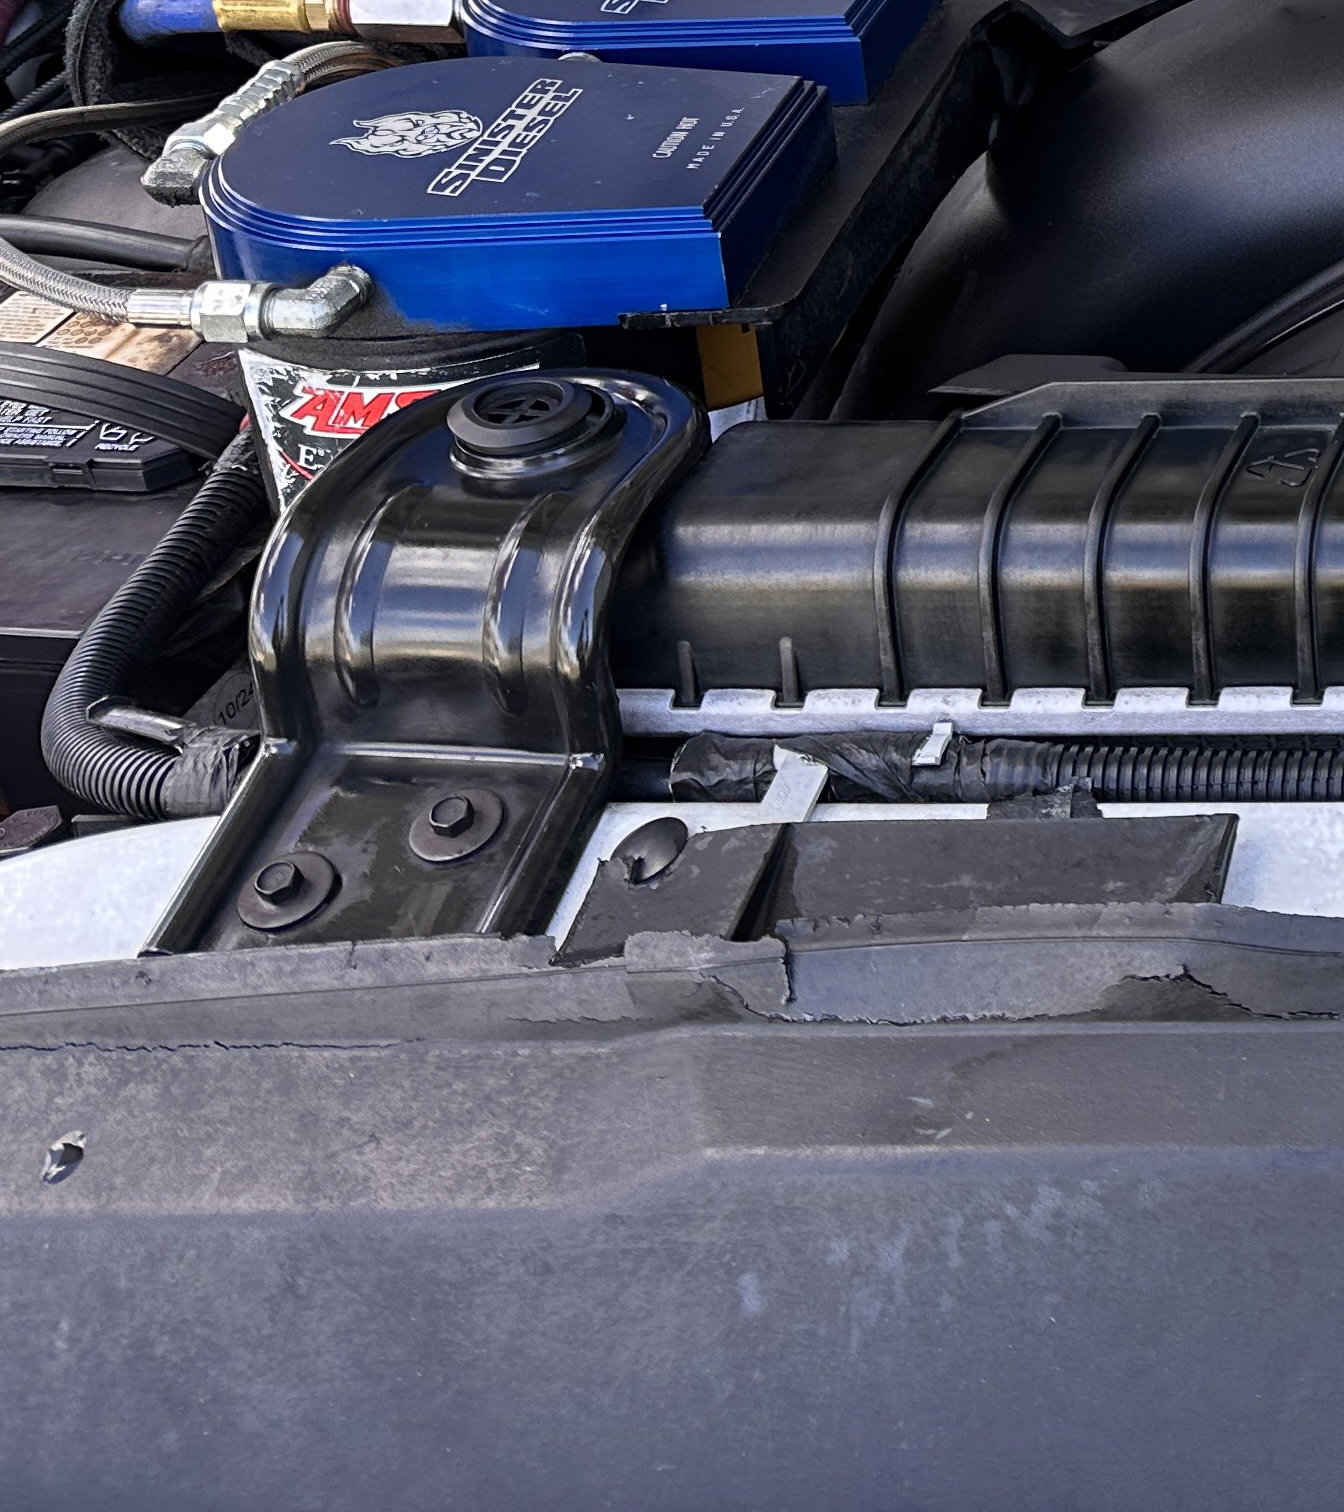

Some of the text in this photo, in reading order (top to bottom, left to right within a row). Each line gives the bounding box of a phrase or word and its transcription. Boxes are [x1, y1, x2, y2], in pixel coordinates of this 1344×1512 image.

[427, 78, 564, 196] SINISTER
[472, 88, 584, 183] DIESEL
[685, 144, 716, 169] MADE
